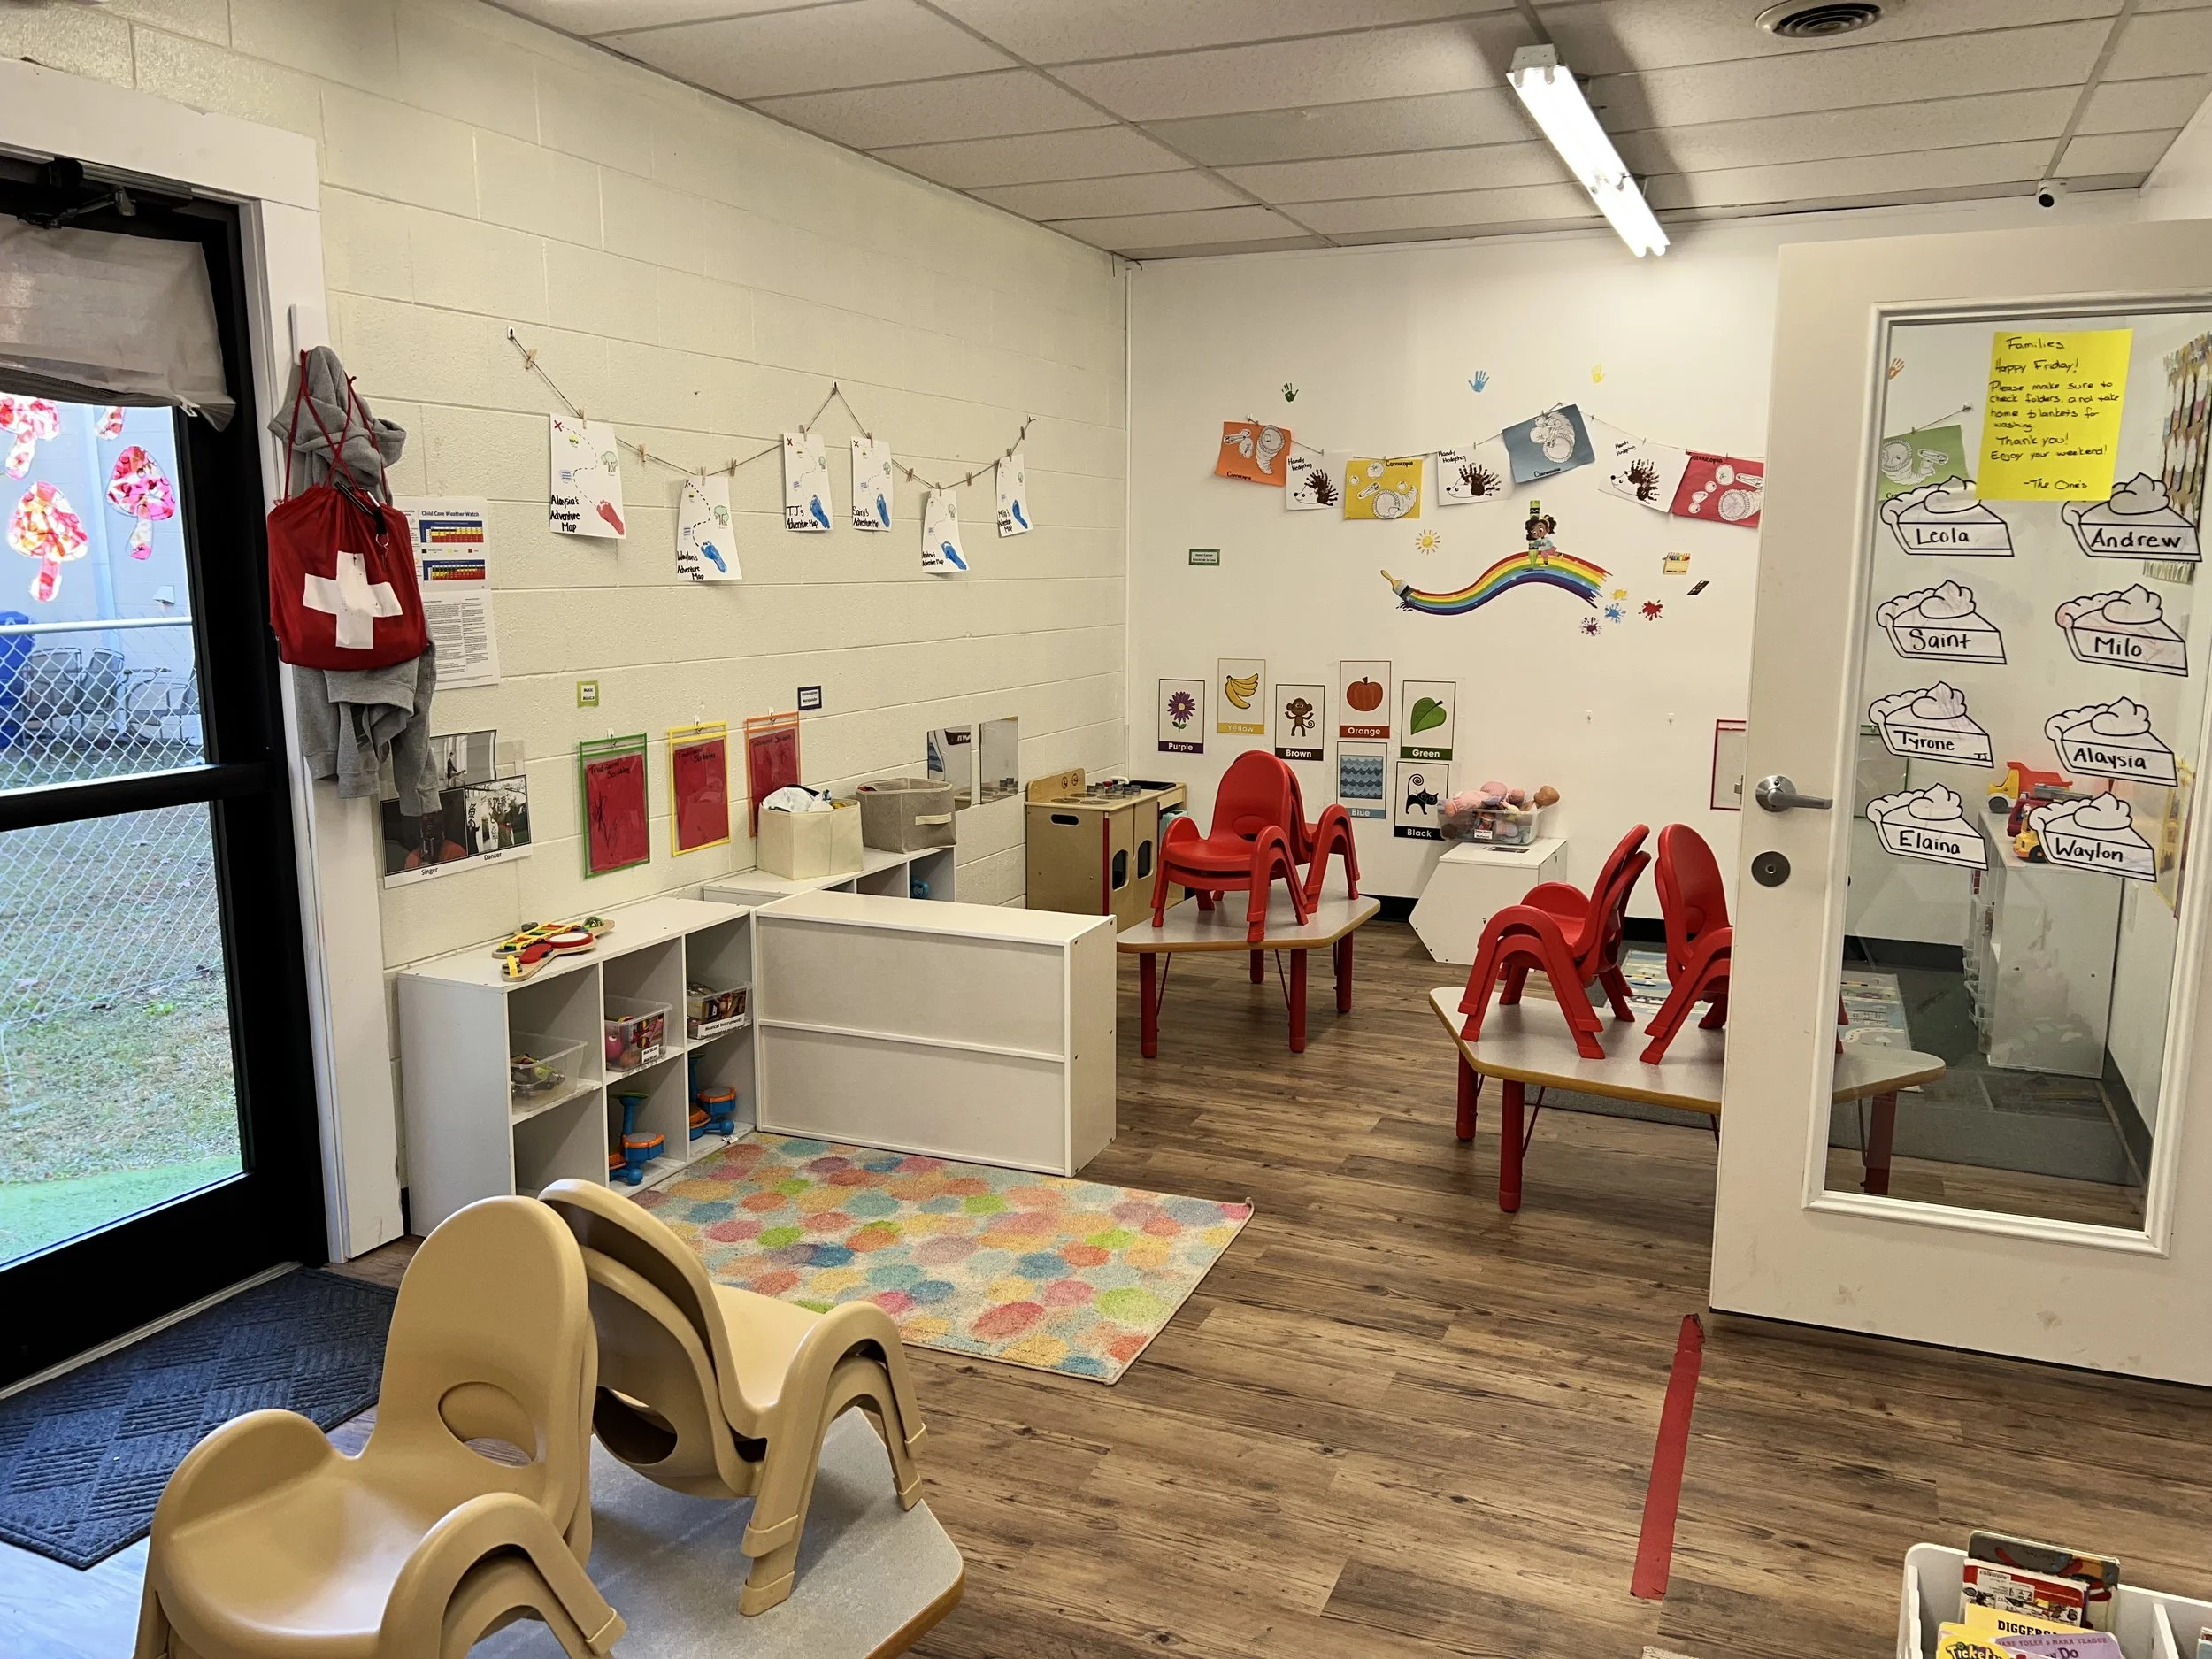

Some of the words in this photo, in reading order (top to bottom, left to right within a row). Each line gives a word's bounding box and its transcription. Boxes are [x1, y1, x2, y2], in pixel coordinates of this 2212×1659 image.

[1995, 357, 2026, 373] Happy
[2033, 358, 2079, 373] Friday!
[1989, 380, 2024, 391] Please
[1989, 394, 2018, 403] check
[2068, 395, 2093, 403] and
[2098, 393, 2120, 402] take
[1991, 406, 2019, 418] home
[2085, 407, 2100, 419] for
[1996, 434, 2038, 446] Thank
[2041, 433, 2070, 447] you!
[1991, 450, 2024, 462] Enjoy
[2031, 451, 2050, 461] your
[2056, 445, 2108, 457] weekend!
[1385, 459, 1414, 468] Cornucopia
[2055, 480, 2088, 490] One's
[550, 494, 580, 509] Alaysia's
[549, 509, 580, 521] Adventure
[561, 522, 577, 534] Map
[786, 518, 809, 529] Adventure
[809, 519, 818, 529] Map
[1916, 528, 1970, 545] Leola
[2090, 528, 2182, 549] Andrew
[691, 572, 705, 581] Map
[1909, 628, 1972, 651] Saint
[2093, 636, 2143, 657] Milo
[1226, 724, 1255, 733] Yellow
[1348, 726, 1381, 737] Orange
[1893, 729, 1955, 751] Tyrone
[1167, 741, 1194, 753] Purple
[1285, 749, 1312, 758] Brown
[1411, 748, 1440, 759] Green
[2073, 747, 2147, 771] Alaysia
[1351, 808, 1371, 818] Blue
[1406, 827, 1432, 839] Black
[1899, 830, 1961, 855] Elaina
[2055, 836, 2124, 864] Waylon
[483, 852, 503, 862] Dancer
[420, 866, 439, 876] Singer
